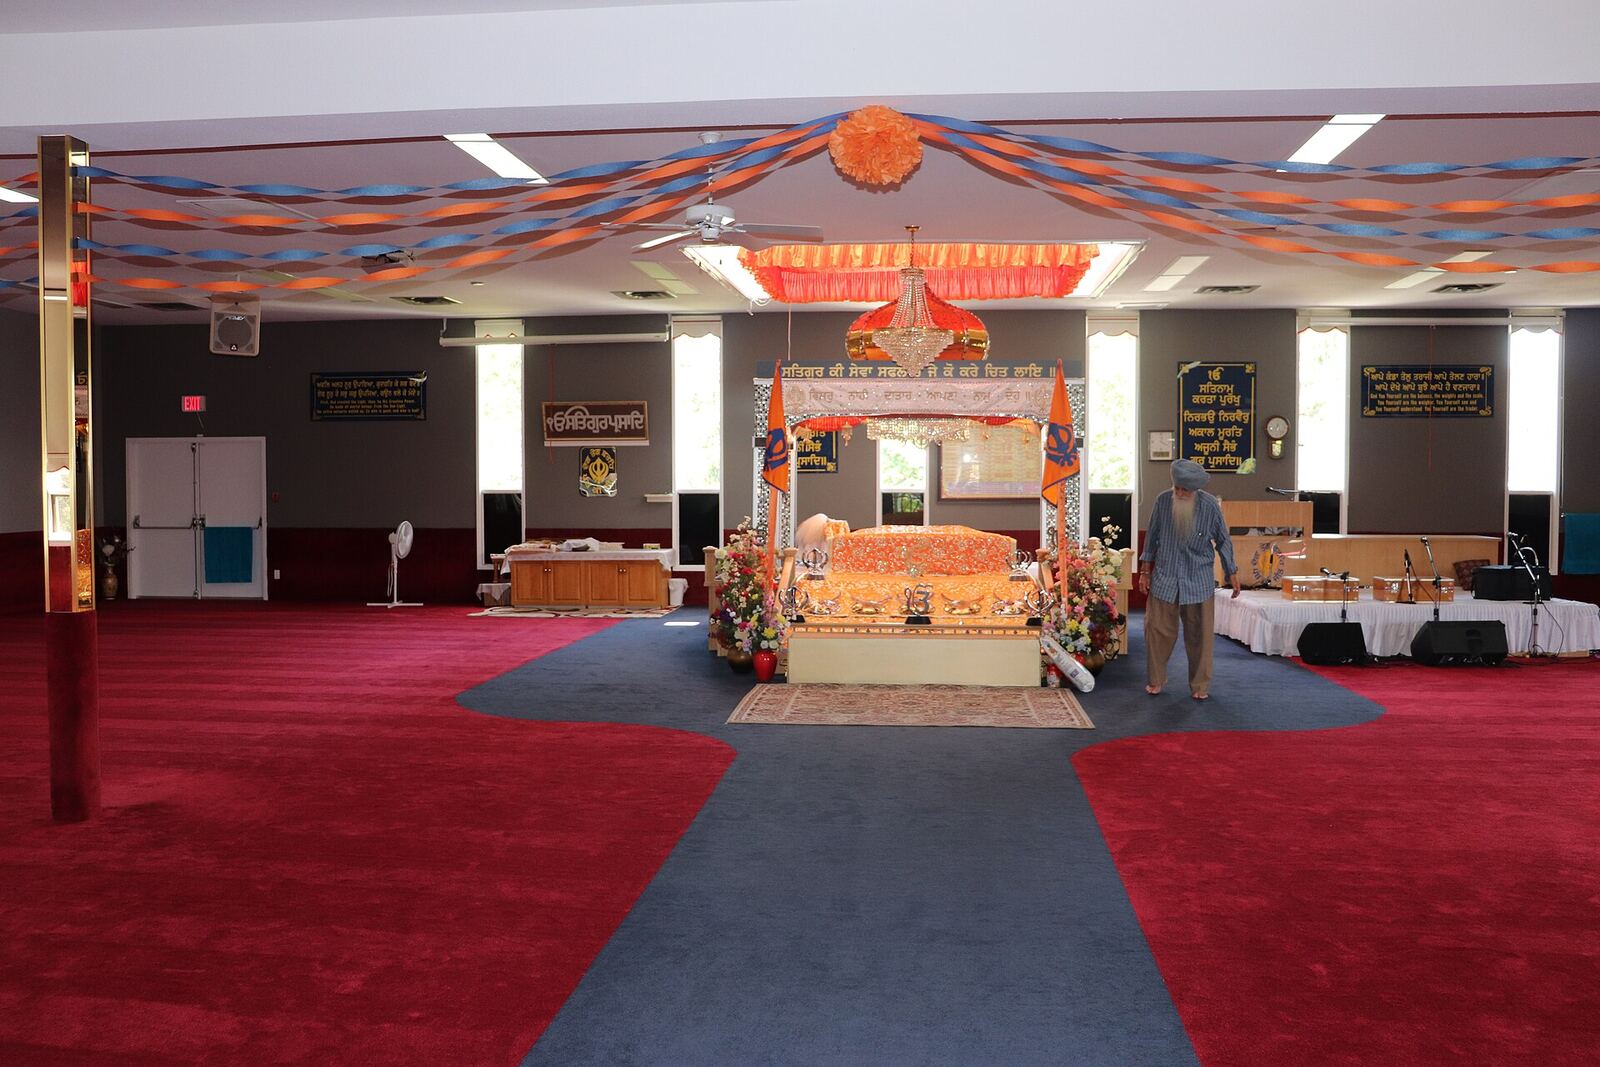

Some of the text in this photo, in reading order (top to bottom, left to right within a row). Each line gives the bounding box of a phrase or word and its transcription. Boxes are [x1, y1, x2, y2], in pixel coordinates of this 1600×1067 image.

[829, 363, 844, 377] ਕੀ
[849, 363, 873, 378] ਸੇਵਾ
[960, 363, 979, 378] ਕਰੇ
[184, 396, 200, 411] EXIT
[1192, 394, 1217, 404] ਕਰਤਾ
[1189, 427, 1215, 437] ਅਕਾਲ
